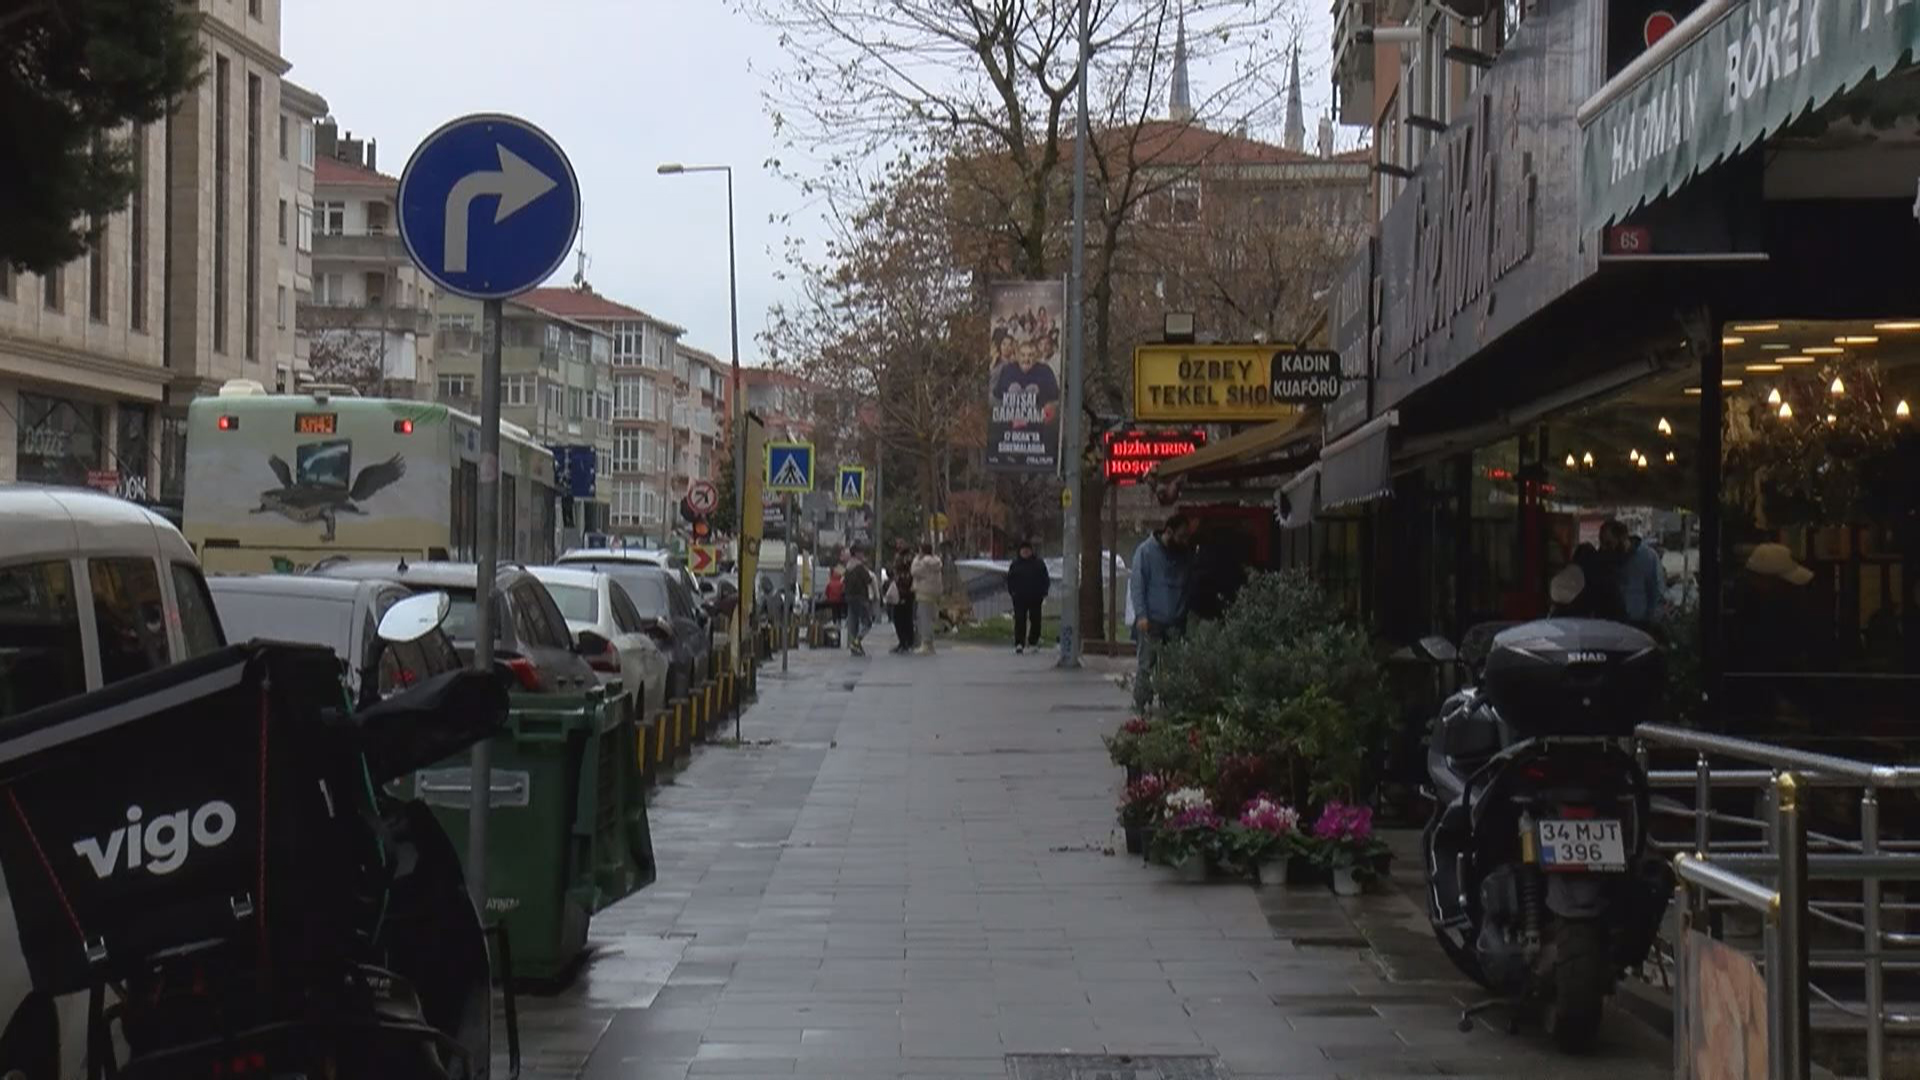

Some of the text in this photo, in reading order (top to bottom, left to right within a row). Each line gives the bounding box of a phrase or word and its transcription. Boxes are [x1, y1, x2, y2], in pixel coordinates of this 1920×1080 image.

[1620, 232, 1639, 250] 65
[1178, 353, 1253, 382] ÖZBEY
[1282, 355, 1330, 373] KADIN
[1148, 386, 1275, 406] TEKEL SHO
[1273, 378, 1338, 397] KUAFÖRÜ
[1113, 440, 1196, 456] BİZİM FIRINA
[1567, 651, 1607, 663] SHAD
[72, 799, 237, 879] vigo
[1543, 823, 1618, 841] 34 MJT
[1561, 843, 1602, 861] 396
